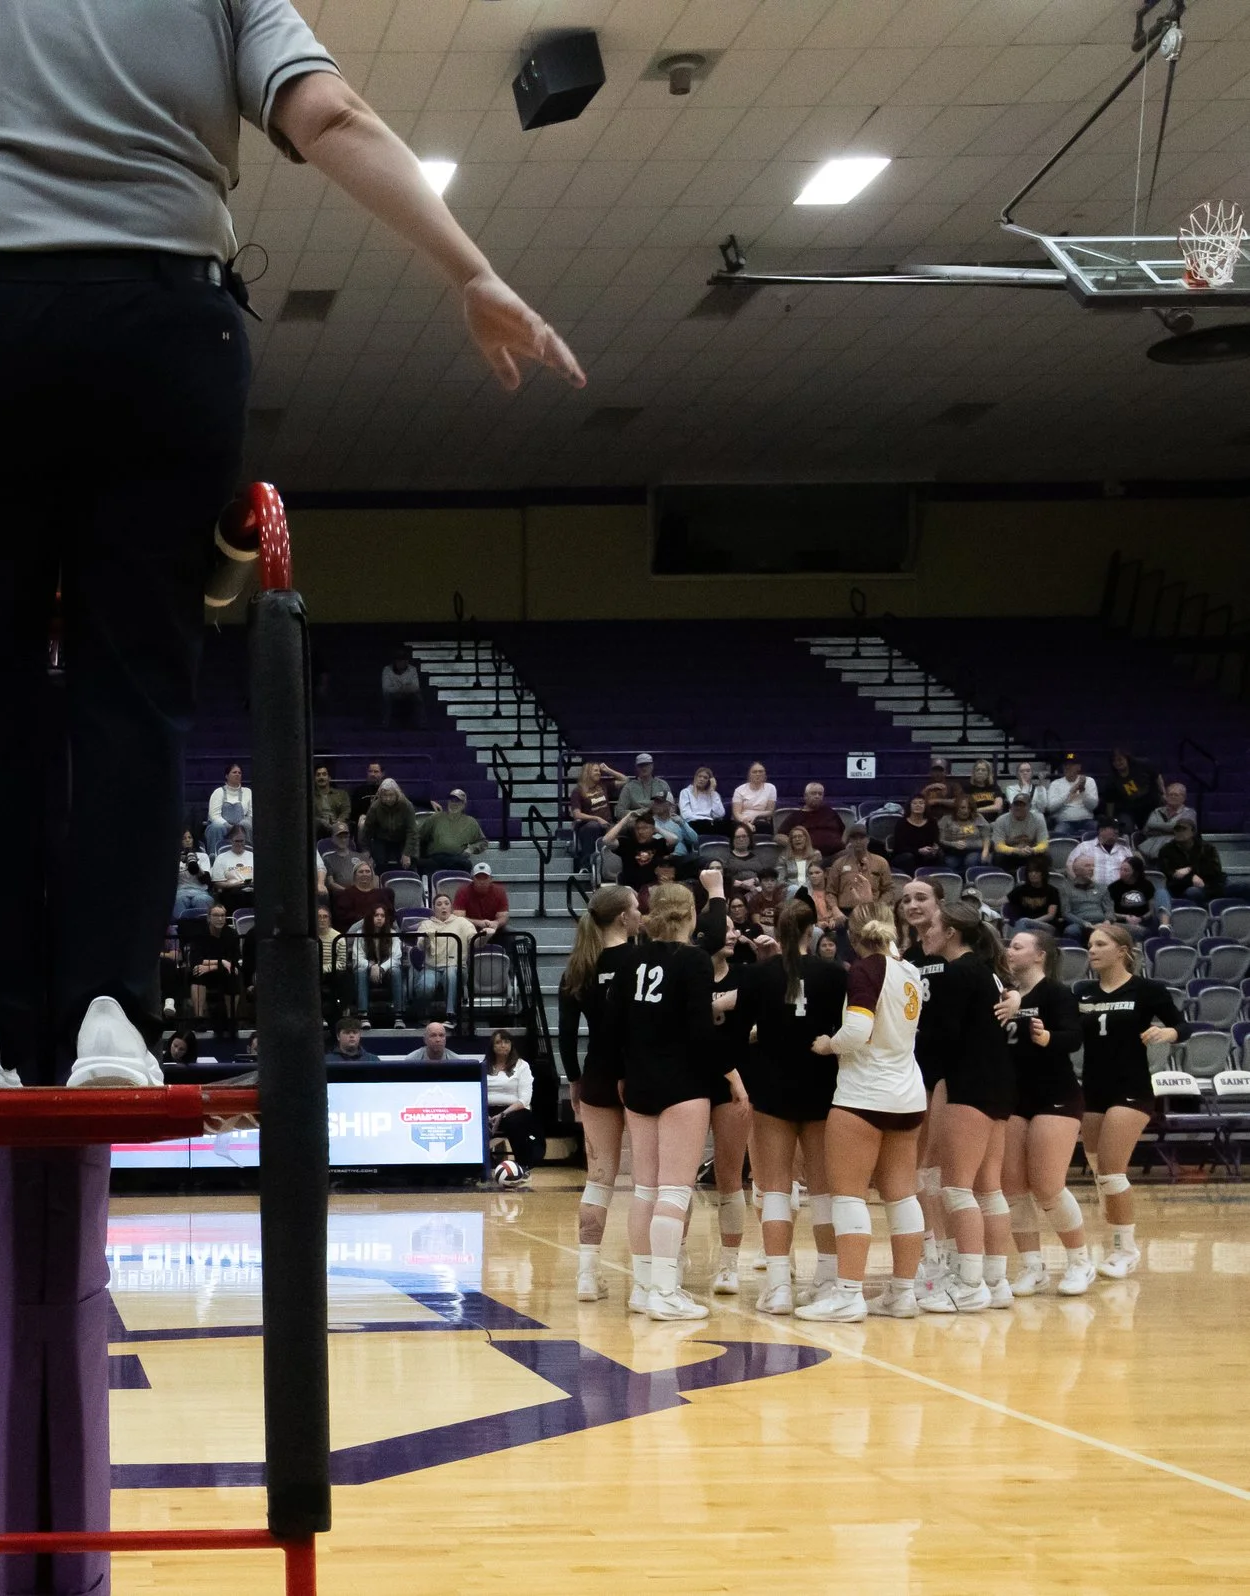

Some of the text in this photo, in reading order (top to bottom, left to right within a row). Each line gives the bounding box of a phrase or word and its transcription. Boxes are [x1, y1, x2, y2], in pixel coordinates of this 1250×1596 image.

[856, 758, 867, 771] C
[634, 963, 664, 1003] 12
[903, 982, 919, 1021] 3
[1098, 1013, 1108, 1036] 1
[1155, 1077, 1192, 1087] SAINTS
[1220, 1077, 1250, 1087] SAINT
[403, 1113, 470, 1121] CHAMPIONSHIP
